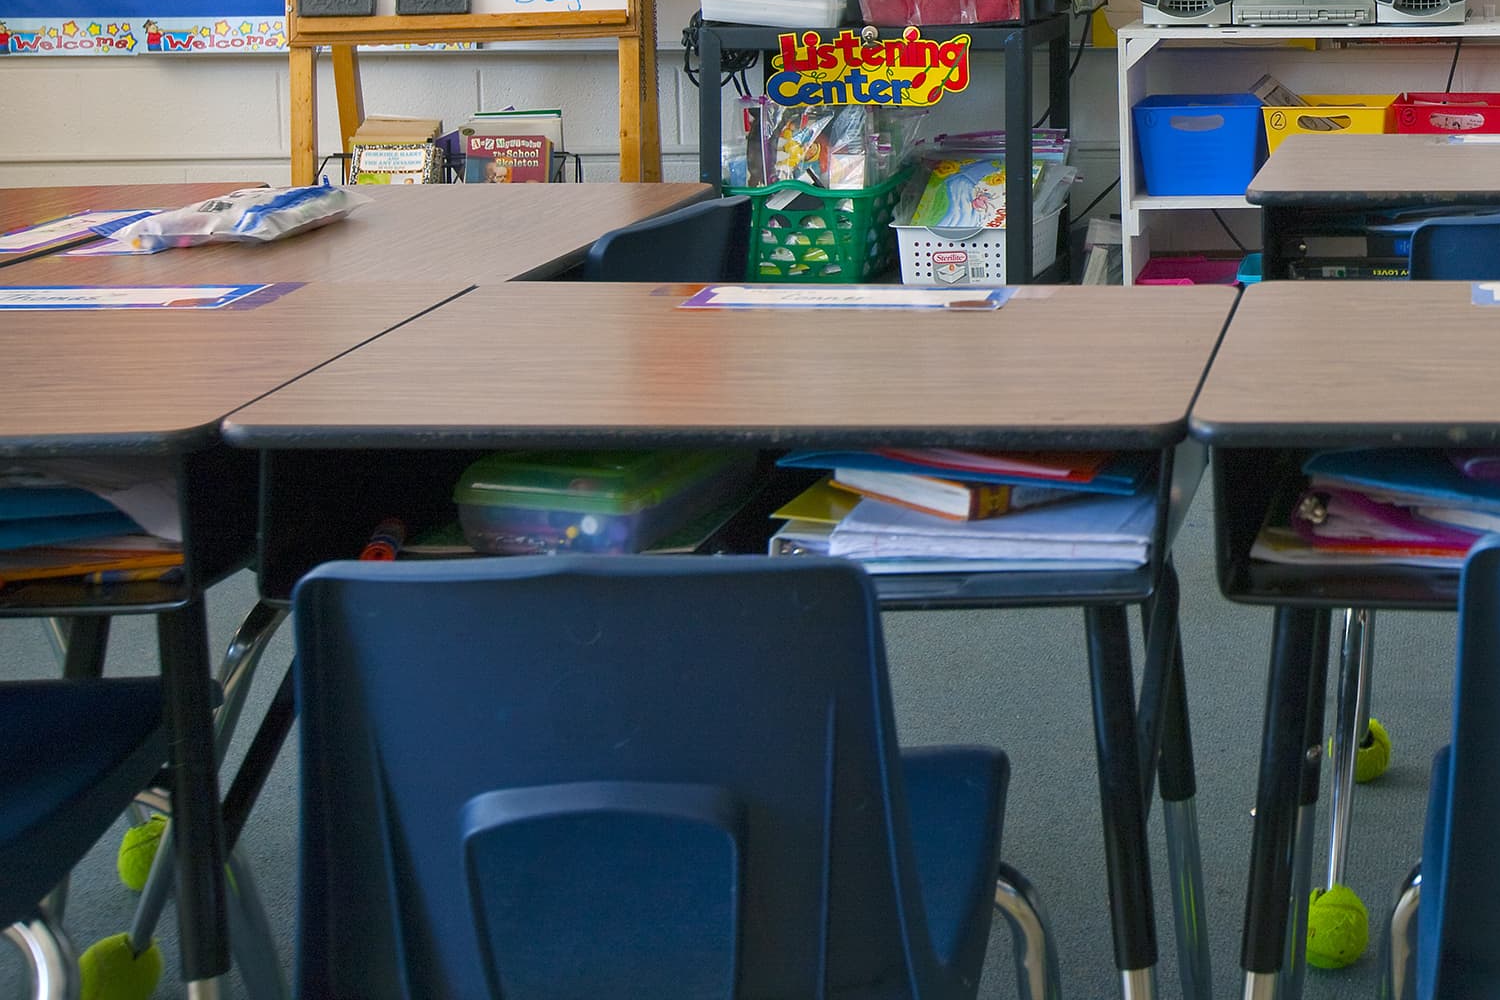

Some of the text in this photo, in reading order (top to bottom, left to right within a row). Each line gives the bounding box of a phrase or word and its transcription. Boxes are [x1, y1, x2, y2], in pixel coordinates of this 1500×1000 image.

[779, 27, 970, 91] Listening
[767, 72, 912, 105] Center
[506, 149, 539, 158] School
[495, 158, 539, 168] Skeleton
[933, 252, 966, 263] Sterilite
